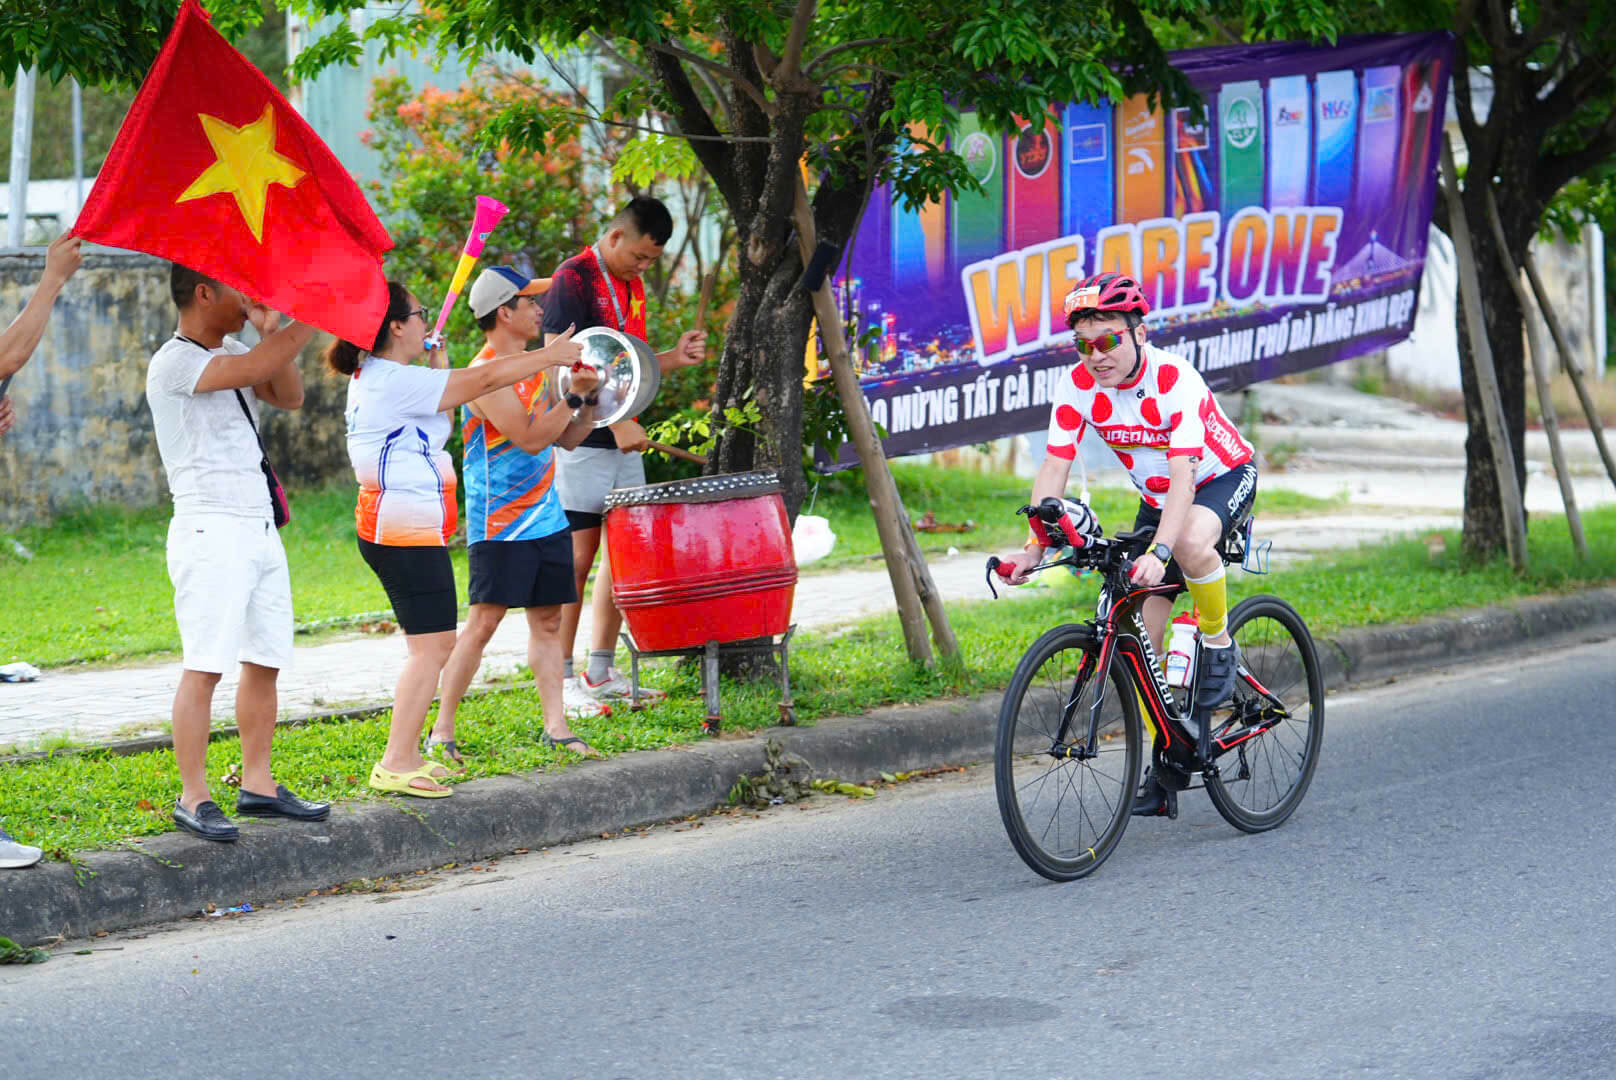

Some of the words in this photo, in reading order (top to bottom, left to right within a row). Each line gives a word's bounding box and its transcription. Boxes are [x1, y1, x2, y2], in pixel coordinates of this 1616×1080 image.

[965, 238, 1083, 364] WE
[1099, 214, 1219, 320] ARE
[1225, 208, 1341, 304] ONE
[891, 385, 959, 434] MỪNG
[962, 370, 1001, 420] TẤT
[1003, 364, 1030, 412] CẢ
[1198, 327, 1255, 373] THÀNH
[1254, 311, 1293, 361] PHỐ
[1311, 302, 1355, 347] NẴNG
[1227, 464, 1257, 512] SUPERMAN
